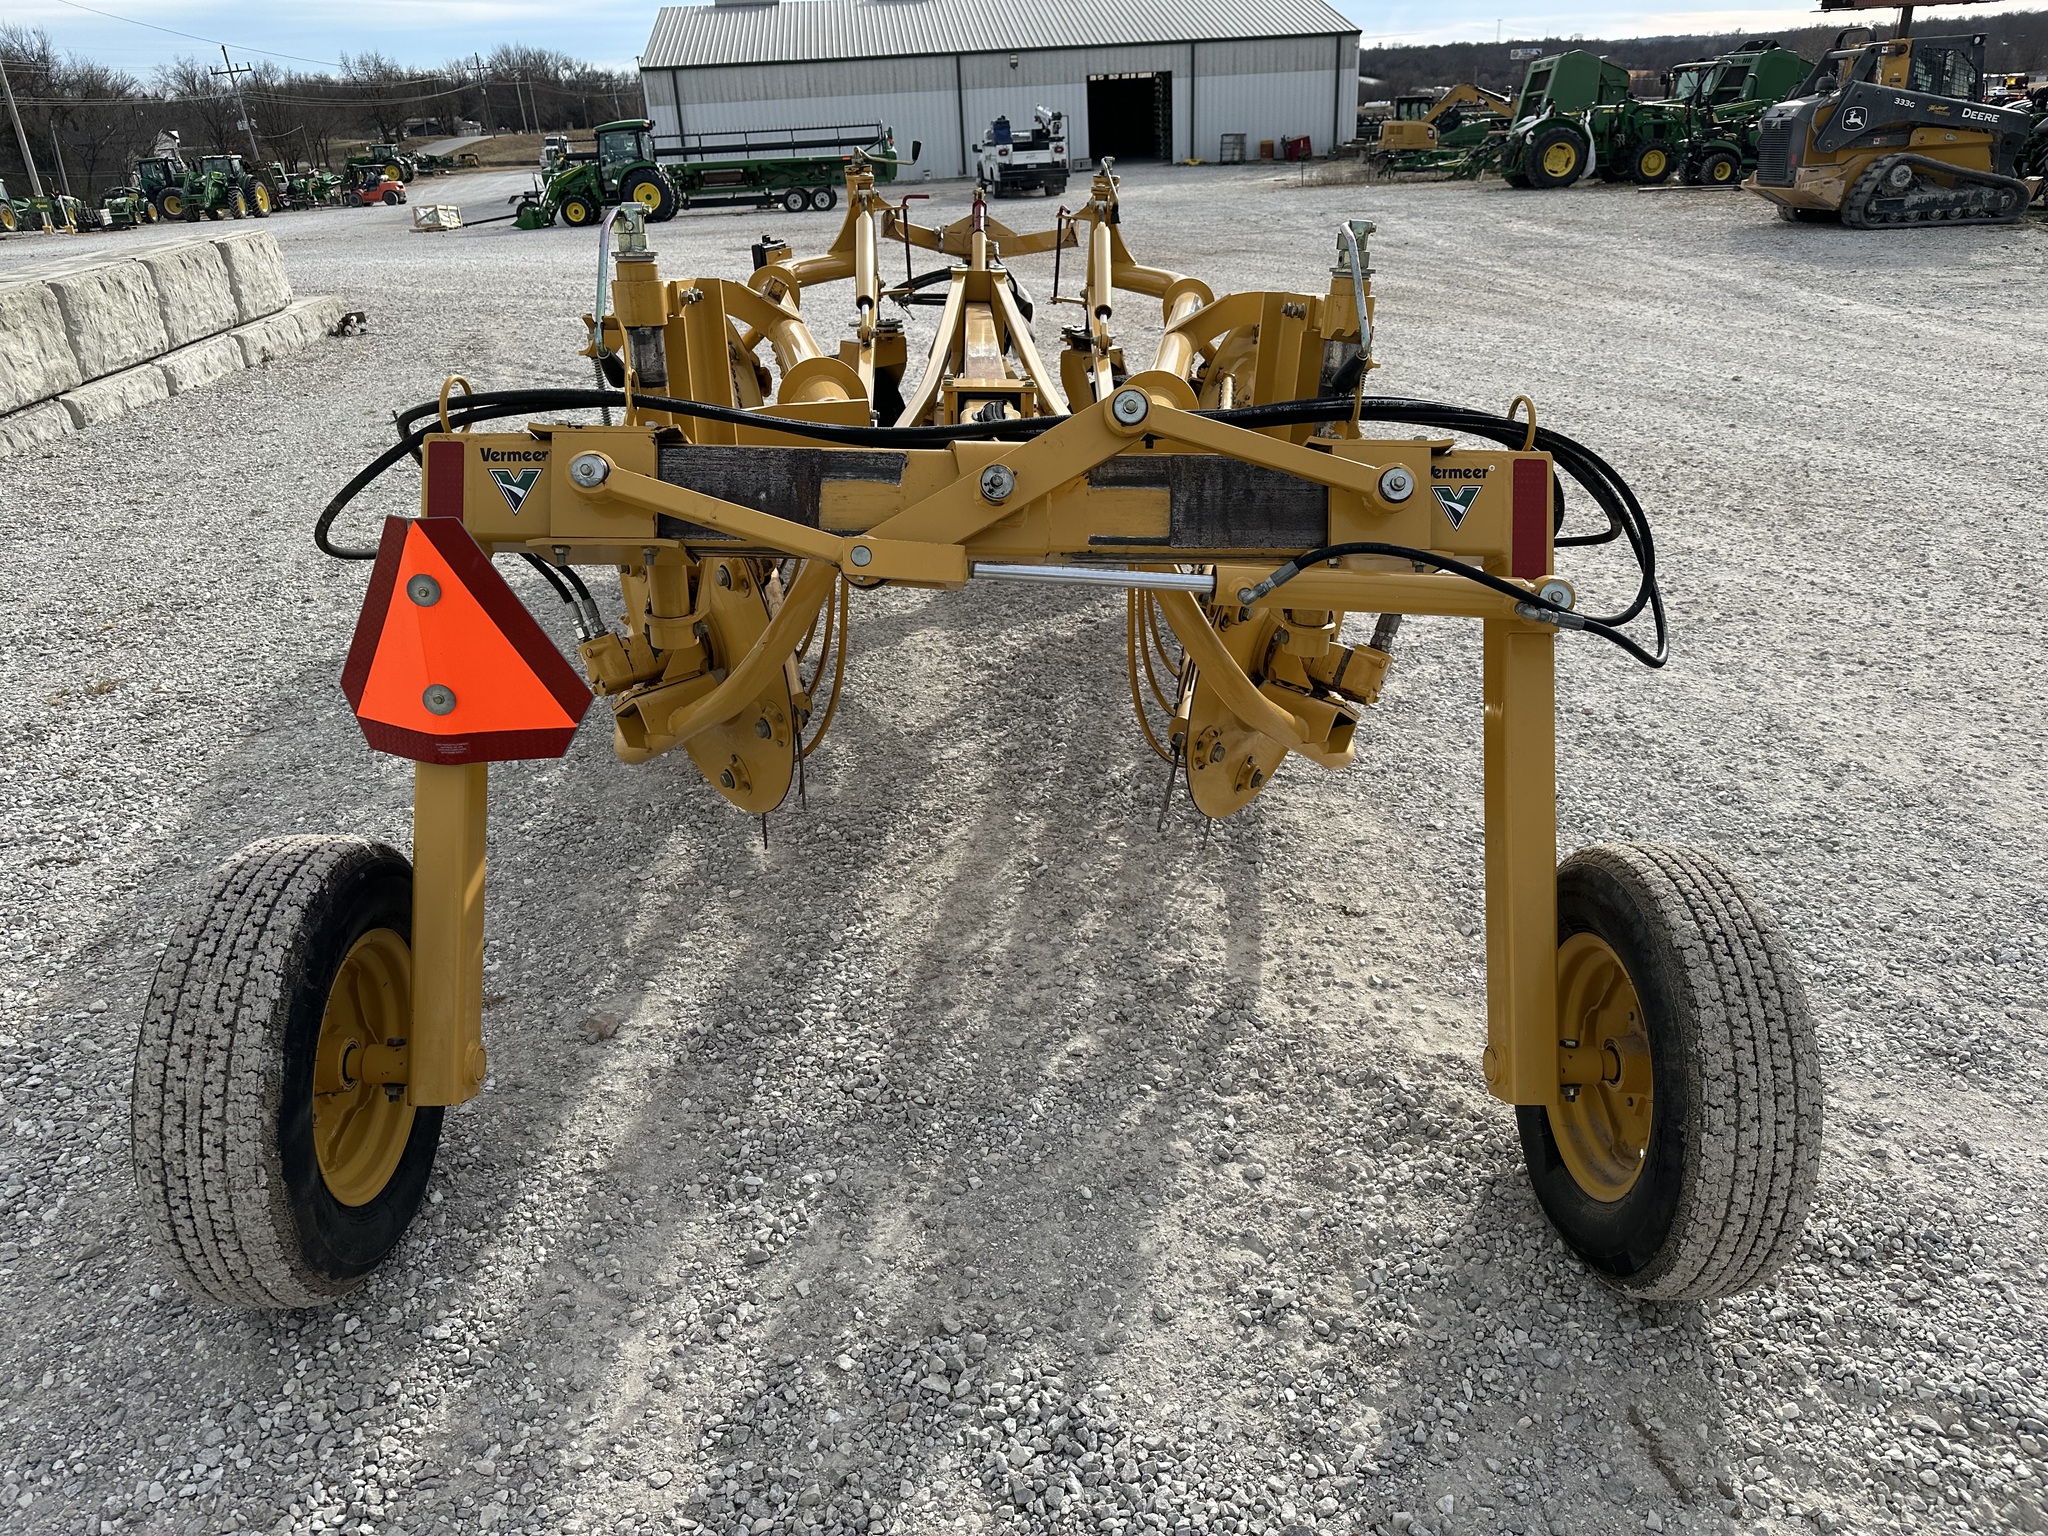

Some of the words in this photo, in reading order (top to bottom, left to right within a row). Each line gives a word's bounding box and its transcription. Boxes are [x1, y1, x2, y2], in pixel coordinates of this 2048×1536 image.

[1894, 97, 1916, 108] 333G
[1961, 107, 2000, 123] DEERE
[480, 447, 549, 462] Vermeer
